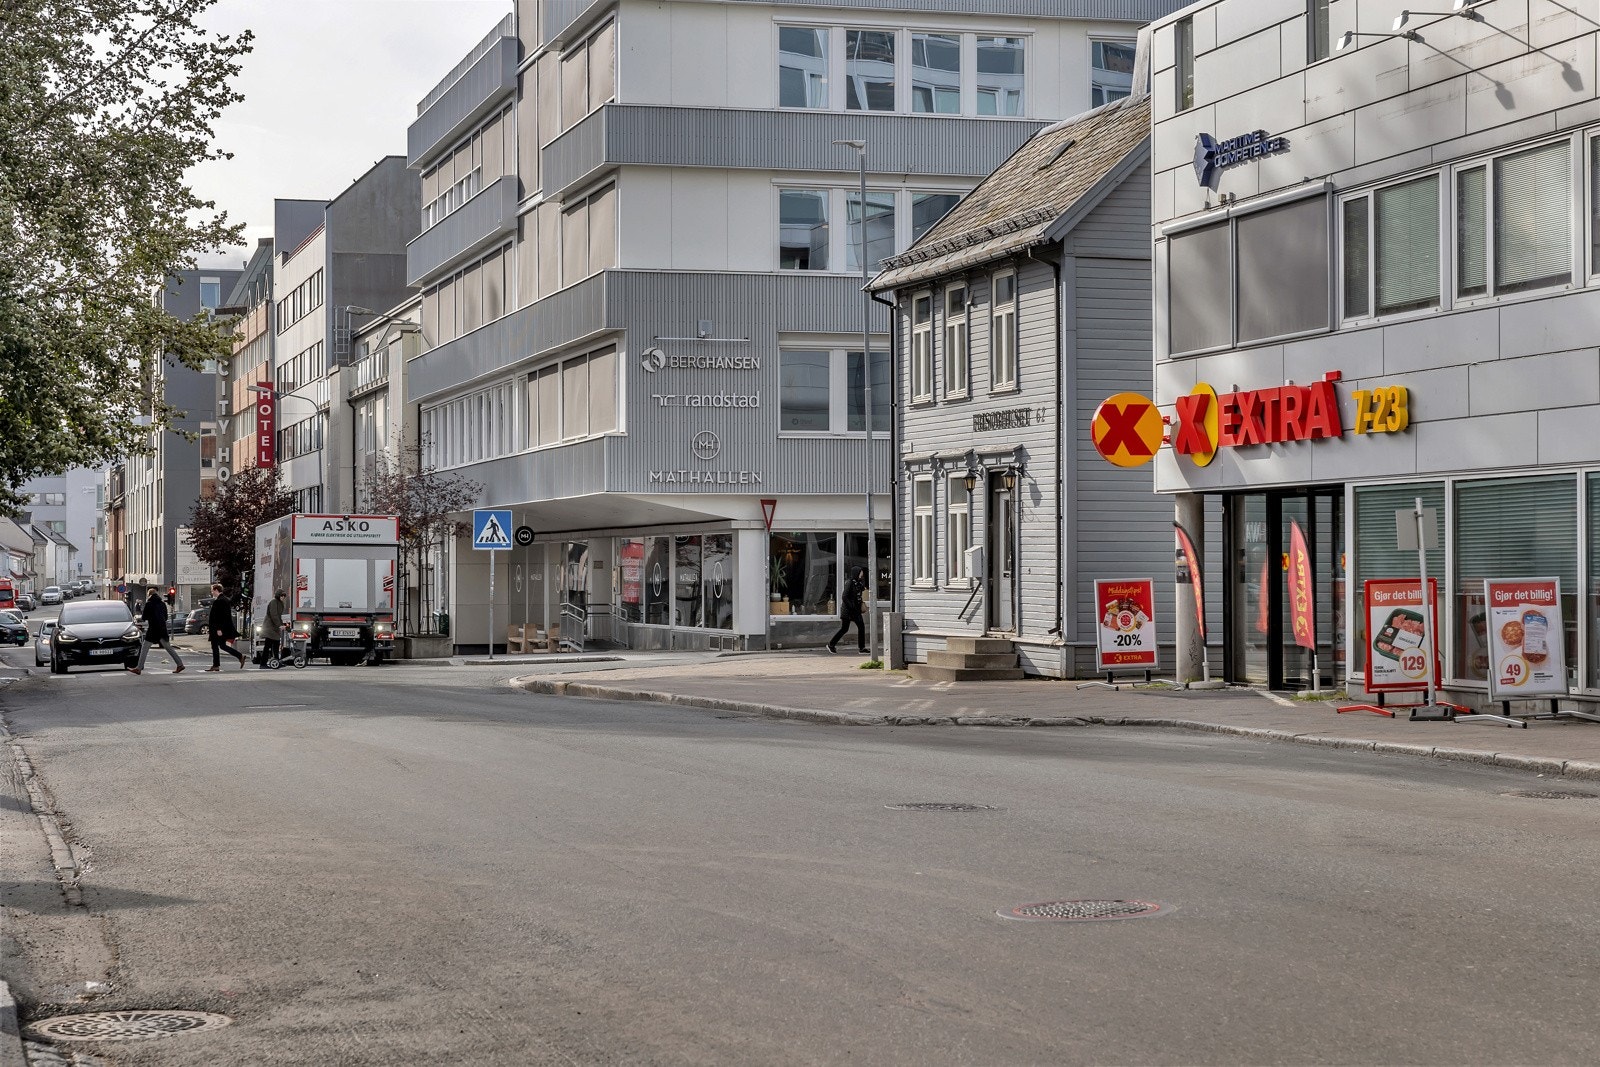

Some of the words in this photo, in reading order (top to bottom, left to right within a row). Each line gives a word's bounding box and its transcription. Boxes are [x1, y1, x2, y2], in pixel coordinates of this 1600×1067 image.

[1215, 131, 1260, 154] MARITIME
[1214, 139, 1280, 167] COMPETENCE
[670, 355, 760, 369] BERGHANSEN
[218, 360, 230, 435] CITY
[685, 390, 760, 408] randstad
[1035, 407, 1047, 424] 62
[1217, 382, 1343, 447] EXTRA
[1353, 385, 1409, 436] 7-23
[260, 390, 272, 462] HOTEL
[650, 470, 762, 484] MATHALLEN
[322, 520, 370, 532] ASKO
[1374, 590, 1391, 602] Gjør
[1392, 590, 1409, 600] det
[1495, 590, 1513, 603] Gjør
[1514, 590, 1529, 600] det
[1530, 589, 1553, 601] billig!
[1113, 633, 1142, 647] -20%
[1401, 655, 1425, 671] 129
[1506, 663, 1521, 676] 49
